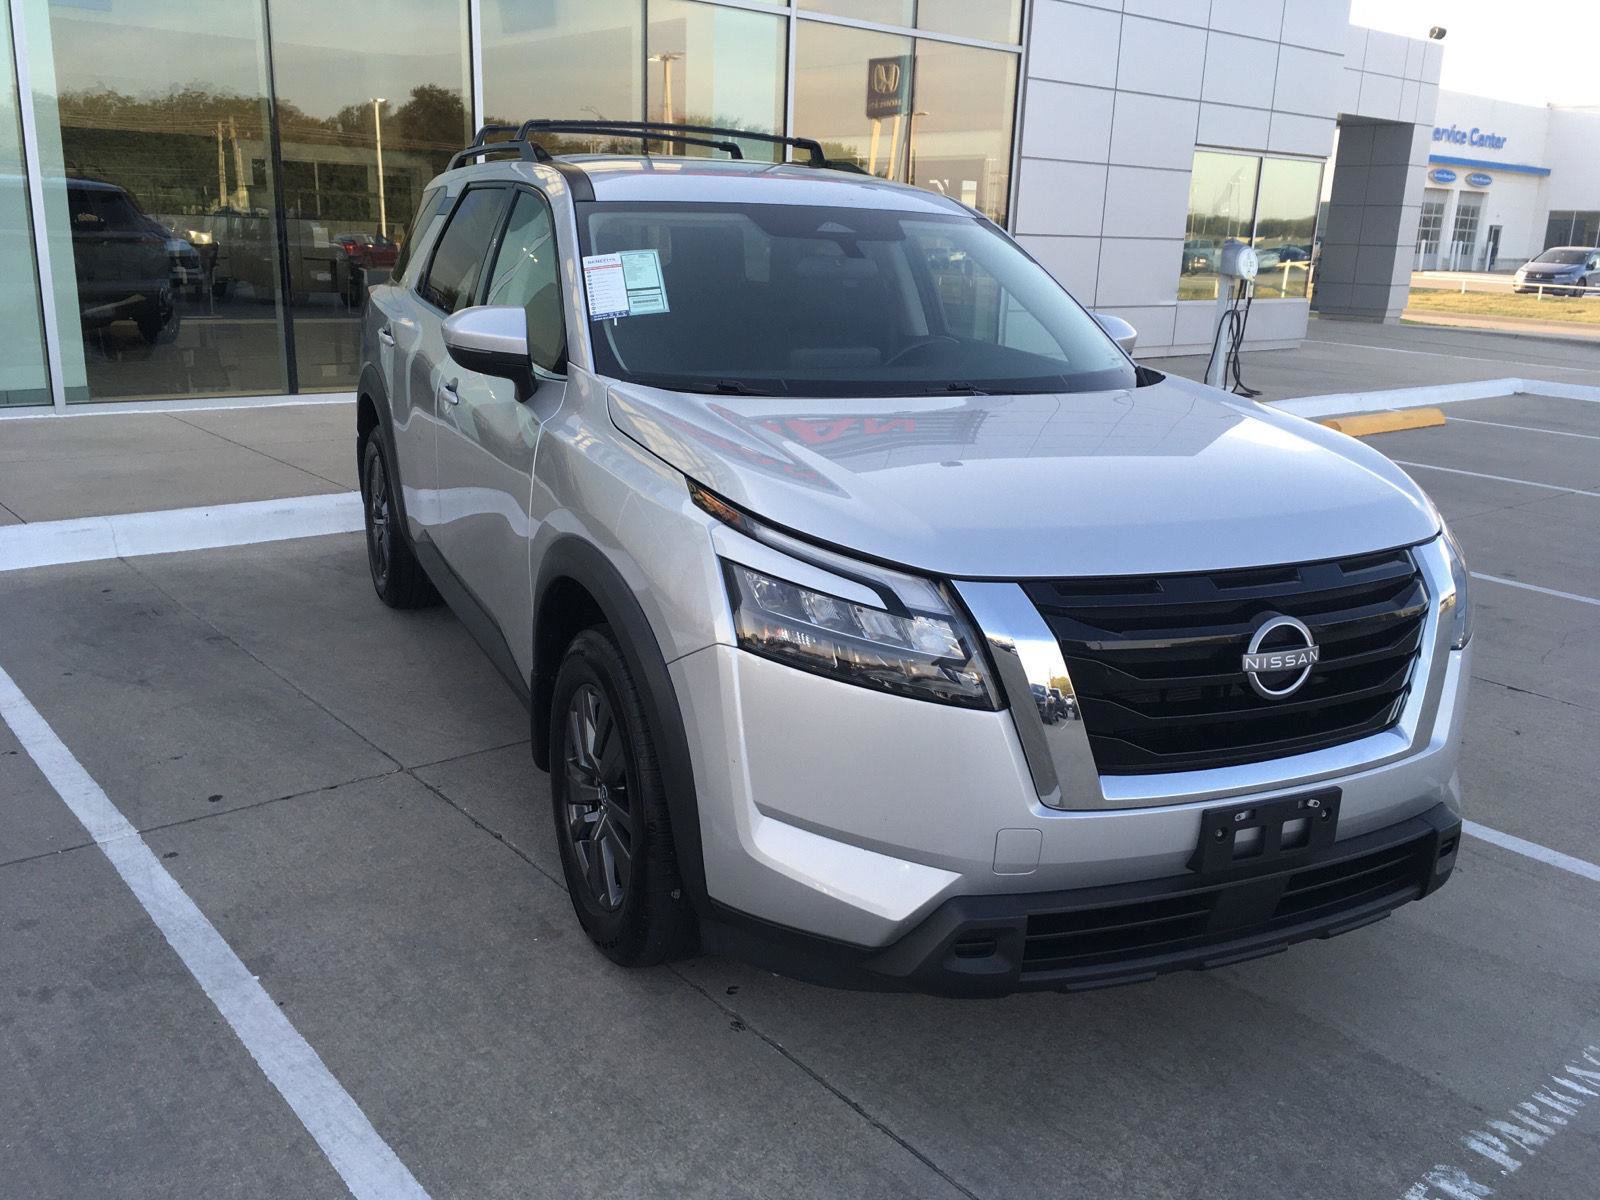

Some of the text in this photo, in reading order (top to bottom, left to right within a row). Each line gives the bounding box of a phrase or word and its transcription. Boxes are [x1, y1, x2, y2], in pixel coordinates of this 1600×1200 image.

[1432, 125, 1507, 149] ervice Center
[1245, 649, 1319, 669] NISSAN
